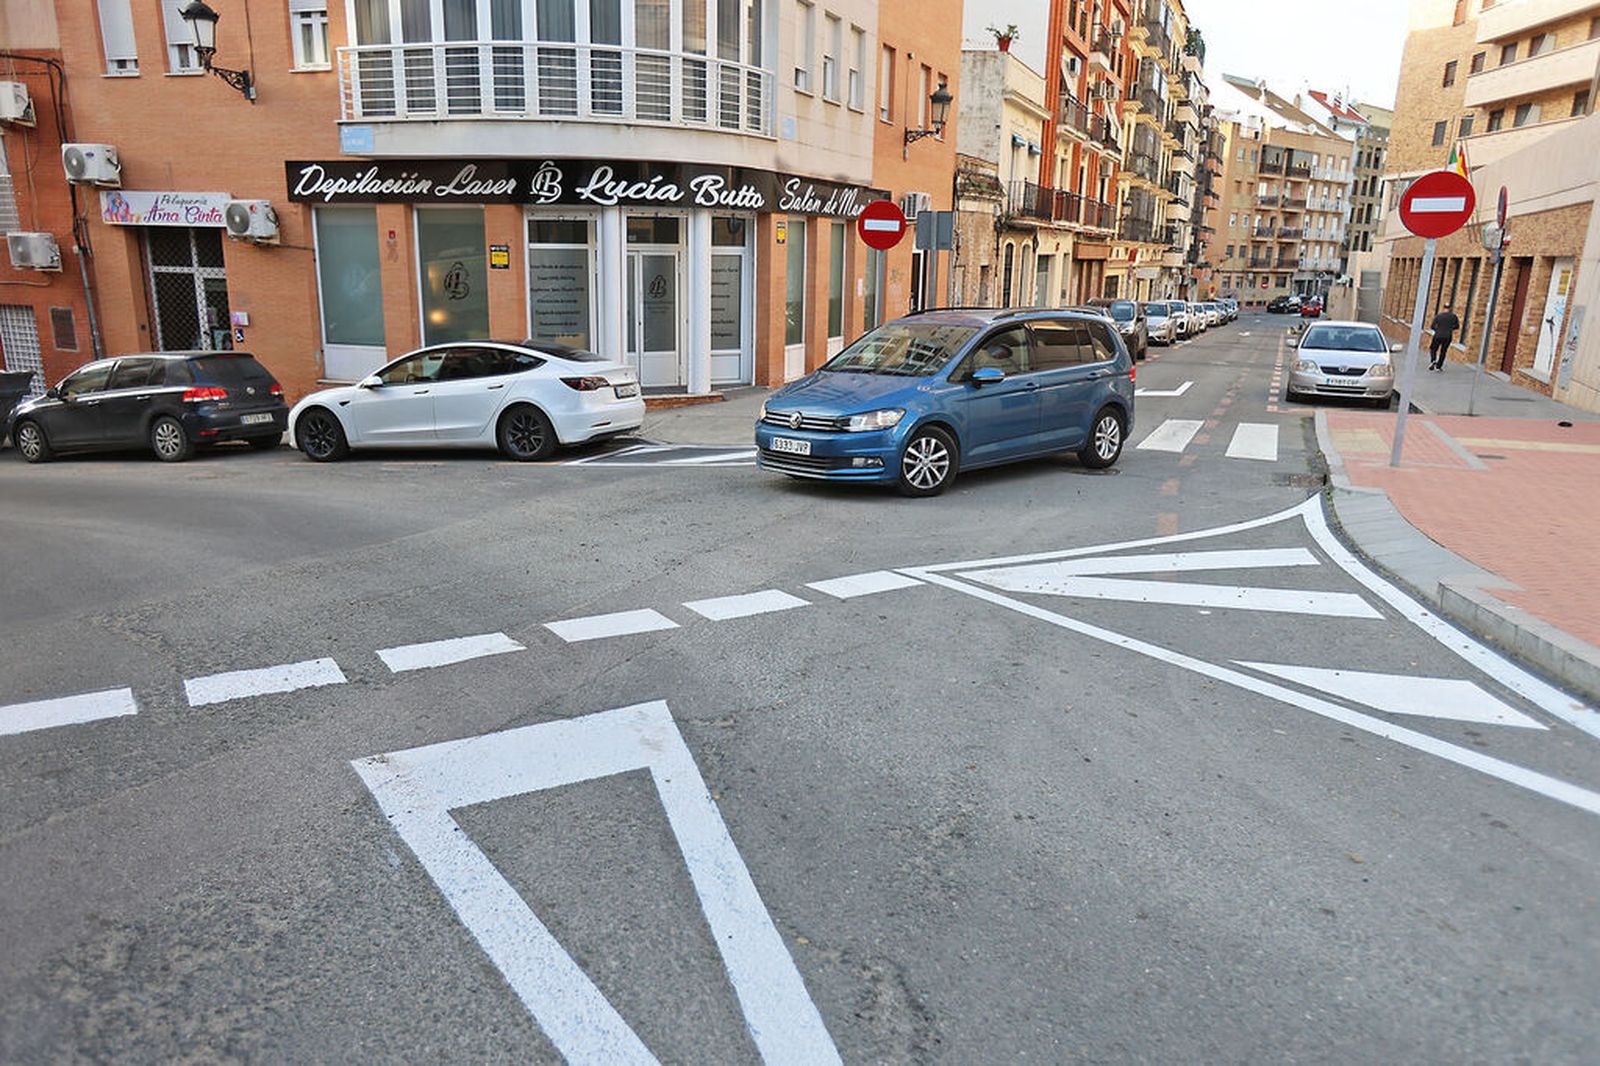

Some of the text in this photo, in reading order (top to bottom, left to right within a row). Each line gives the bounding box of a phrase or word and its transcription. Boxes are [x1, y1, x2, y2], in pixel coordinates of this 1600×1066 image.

[293, 163, 518, 202] Depilación Laser
[575, 165, 765, 209] Lucía Butto
[779, 177, 821, 213] Salón
[821, 188, 837, 216] de
[184, 205, 224, 224] Cinta
